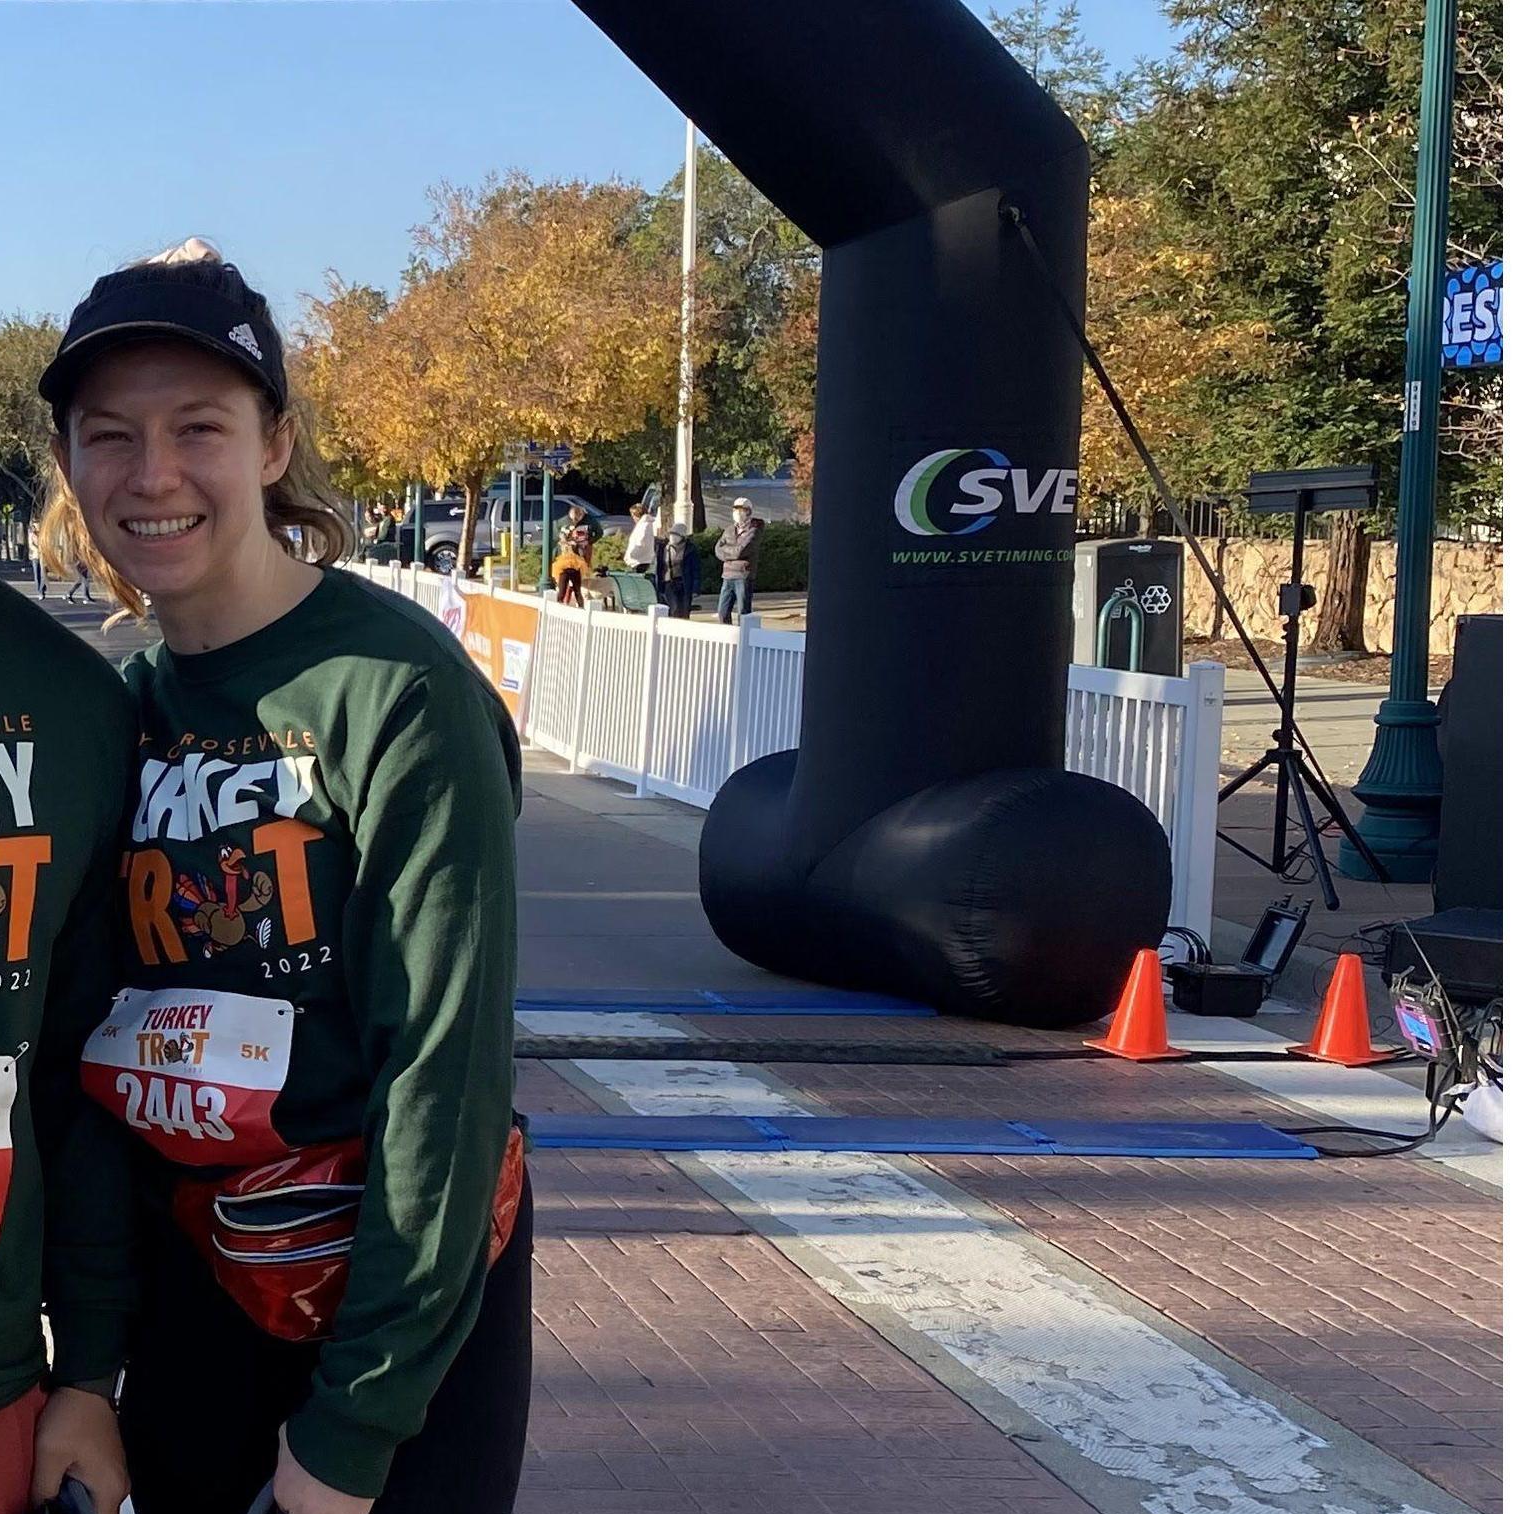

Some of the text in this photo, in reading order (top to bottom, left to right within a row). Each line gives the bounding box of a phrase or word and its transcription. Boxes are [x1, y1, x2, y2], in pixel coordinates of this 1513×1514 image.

[228, 326, 263, 361] adidas
[950, 468, 1078, 514] SVE
[261, 946, 332, 978] 2022
[101, 1024, 121, 1039] 5K
[141, 1004, 214, 1032] TURKEY
[241, 1043, 271, 1062] 5K
[115, 1072, 236, 1142] 2443
